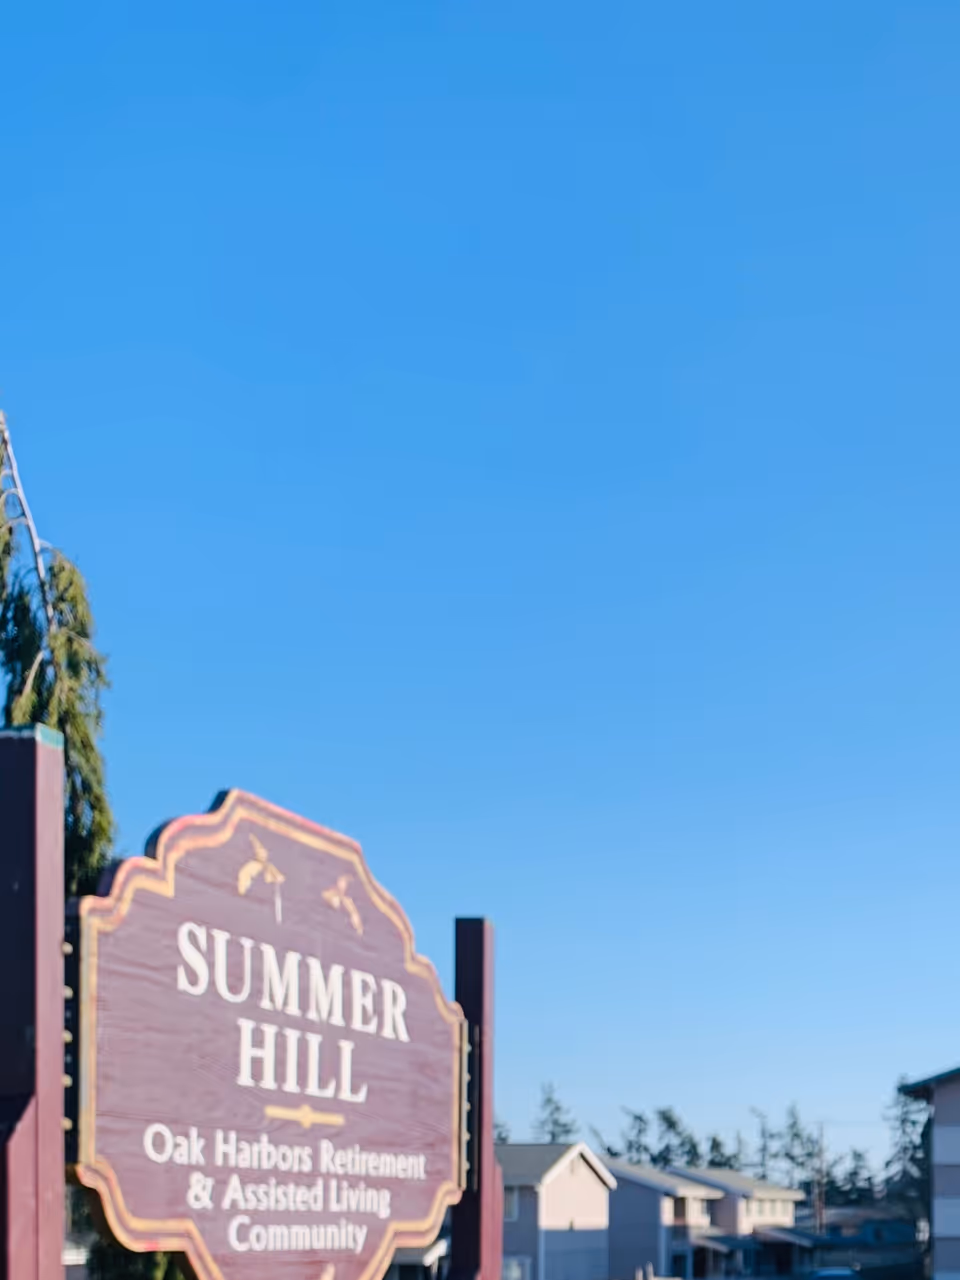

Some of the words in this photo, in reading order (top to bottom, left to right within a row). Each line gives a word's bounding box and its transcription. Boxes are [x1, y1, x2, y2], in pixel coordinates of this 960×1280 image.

[176, 921, 411, 1043] SUMMER
[236, 1018, 368, 1103] HILL
[144, 1123, 206, 1166] Oak
[215, 1130, 313, 1173] Harbors
[320, 1137, 426, 1181] Retirement
[186, 1173, 216, 1210] &
[222, 1173, 324, 1212] Assisted
[329, 1181, 391, 1219] Living
[228, 1215, 368, 1254] Community
